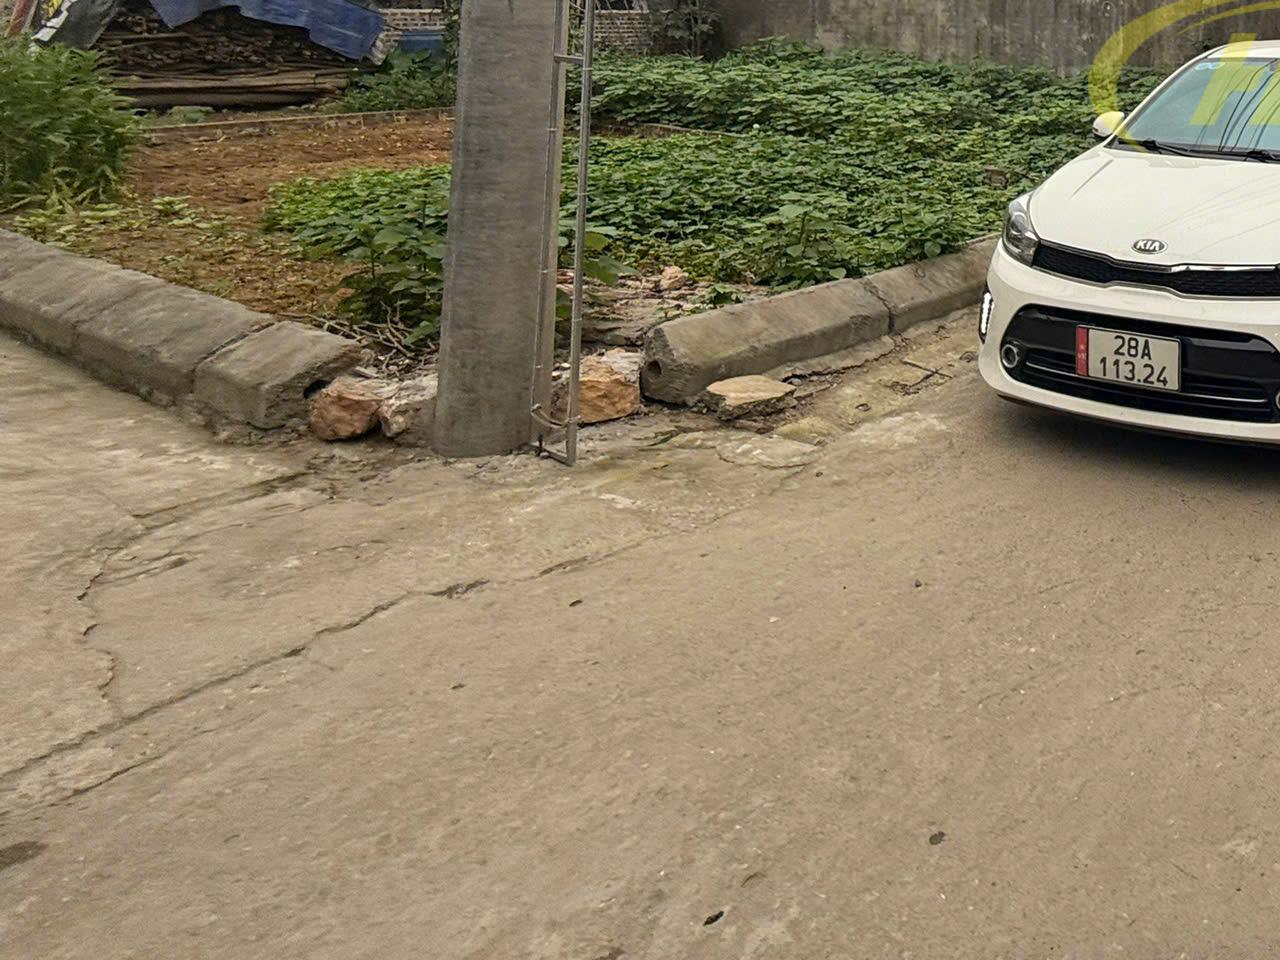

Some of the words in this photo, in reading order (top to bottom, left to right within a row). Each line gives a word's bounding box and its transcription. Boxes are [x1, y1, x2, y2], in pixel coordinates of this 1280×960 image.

[1135, 240, 1161, 251] KIA
[1113, 335, 1152, 360] 28A
[1100, 356, 1169, 387] 113.24
